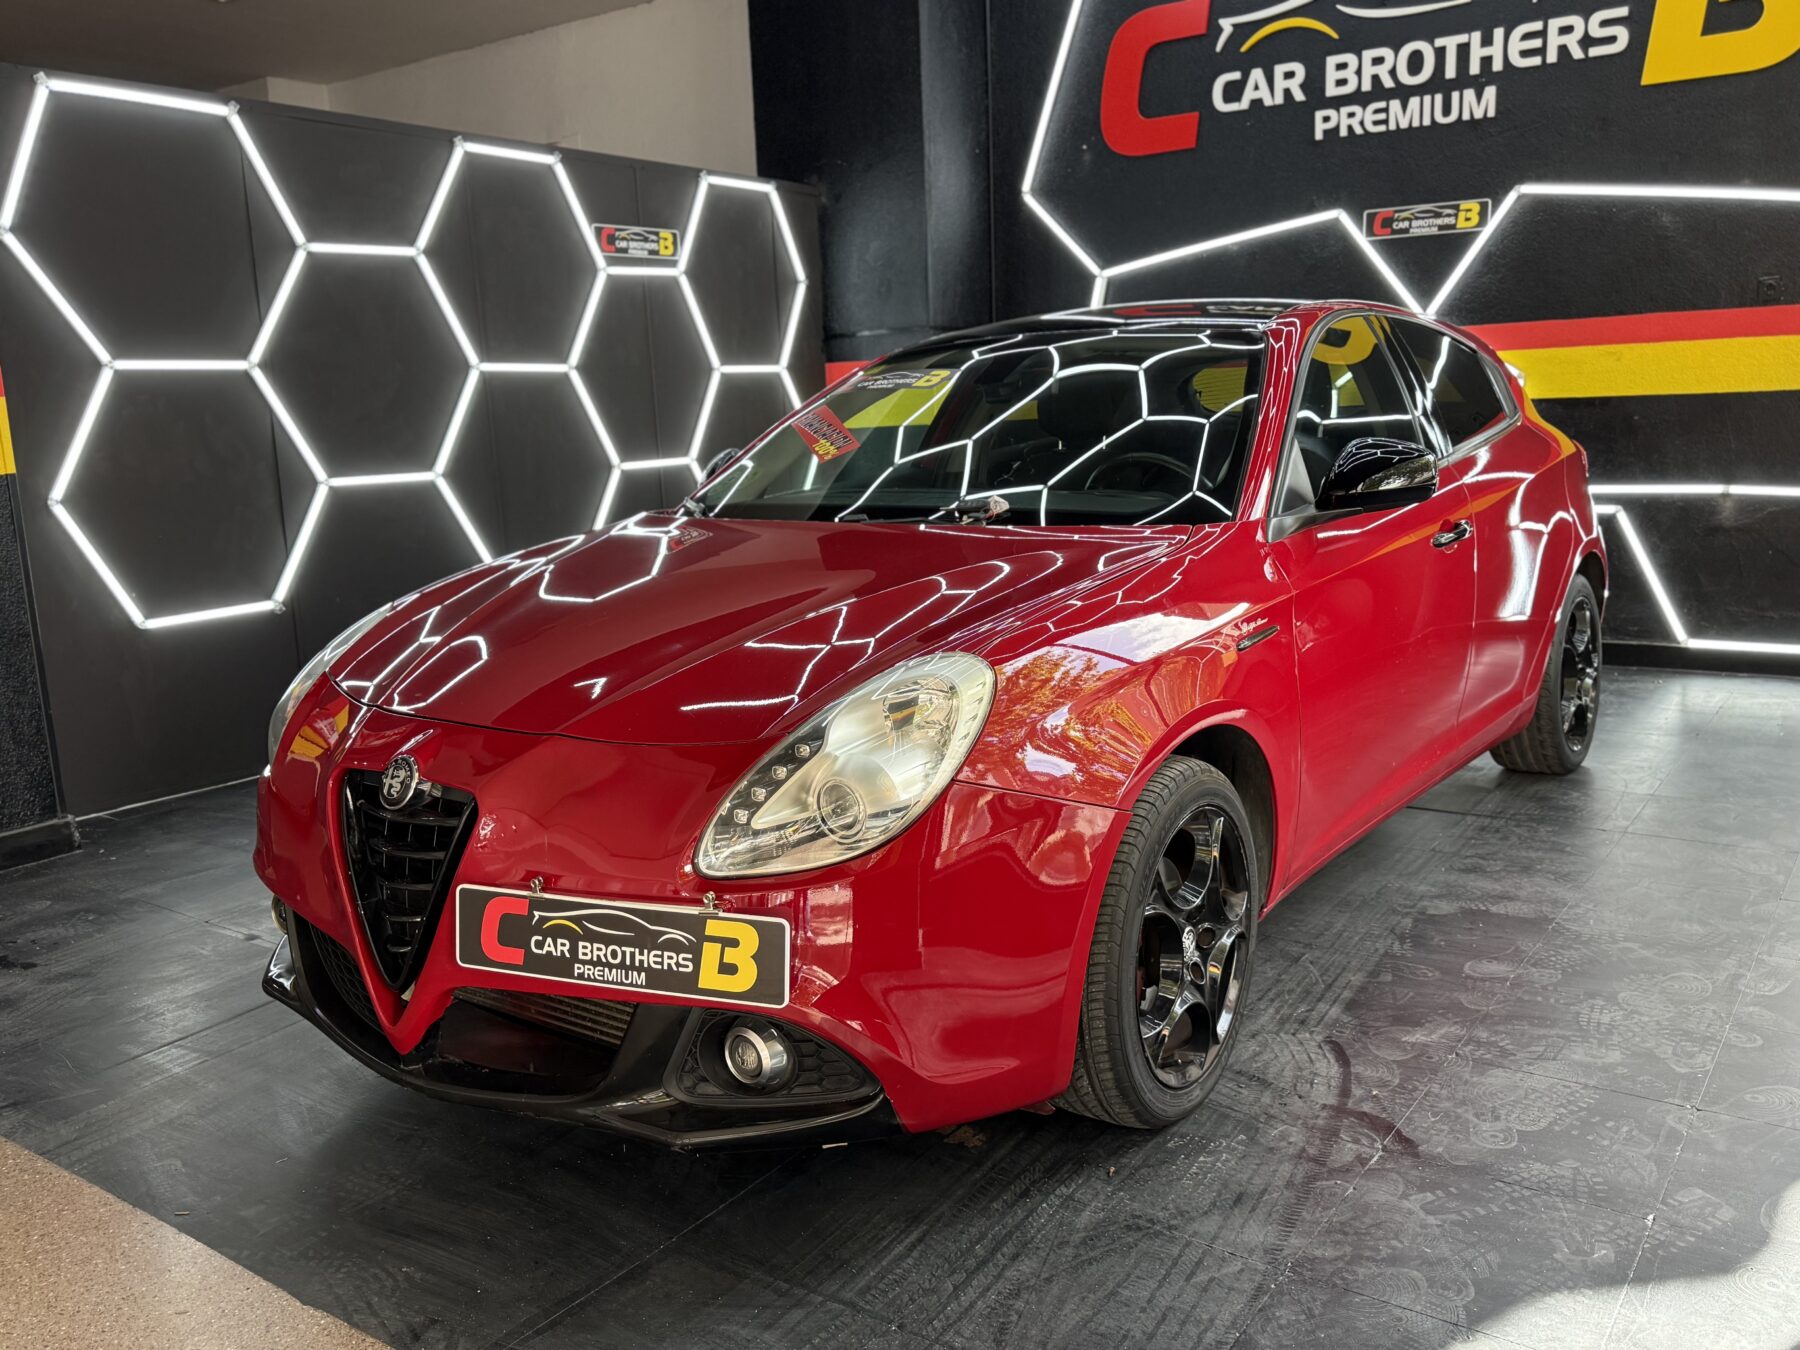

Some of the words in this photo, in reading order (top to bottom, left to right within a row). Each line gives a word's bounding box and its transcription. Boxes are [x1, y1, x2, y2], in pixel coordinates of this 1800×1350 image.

[1211, 61, 1307, 113] CAR
[1324, 6, 1630, 98] BROTHERS
[1100, 0, 1210, 157] C
[1314, 85, 1497, 141] PREMIUM
[1373, 209, 1395, 236] C
[1392, 220, 1410, 230] CAR
[1411, 216, 1458, 228] BROTHERS
[1456, 202, 1481, 229] B
[601, 227, 616, 253] C
[659, 231, 674, 256] B
[812, 440, 840, 460] 100%
[480, 896, 530, 966] C
[530, 935, 571, 958] CAR
[578, 941, 694, 973] BROTHERS
[697, 918, 760, 993] B
[574, 963, 646, 986] PREMIUM
